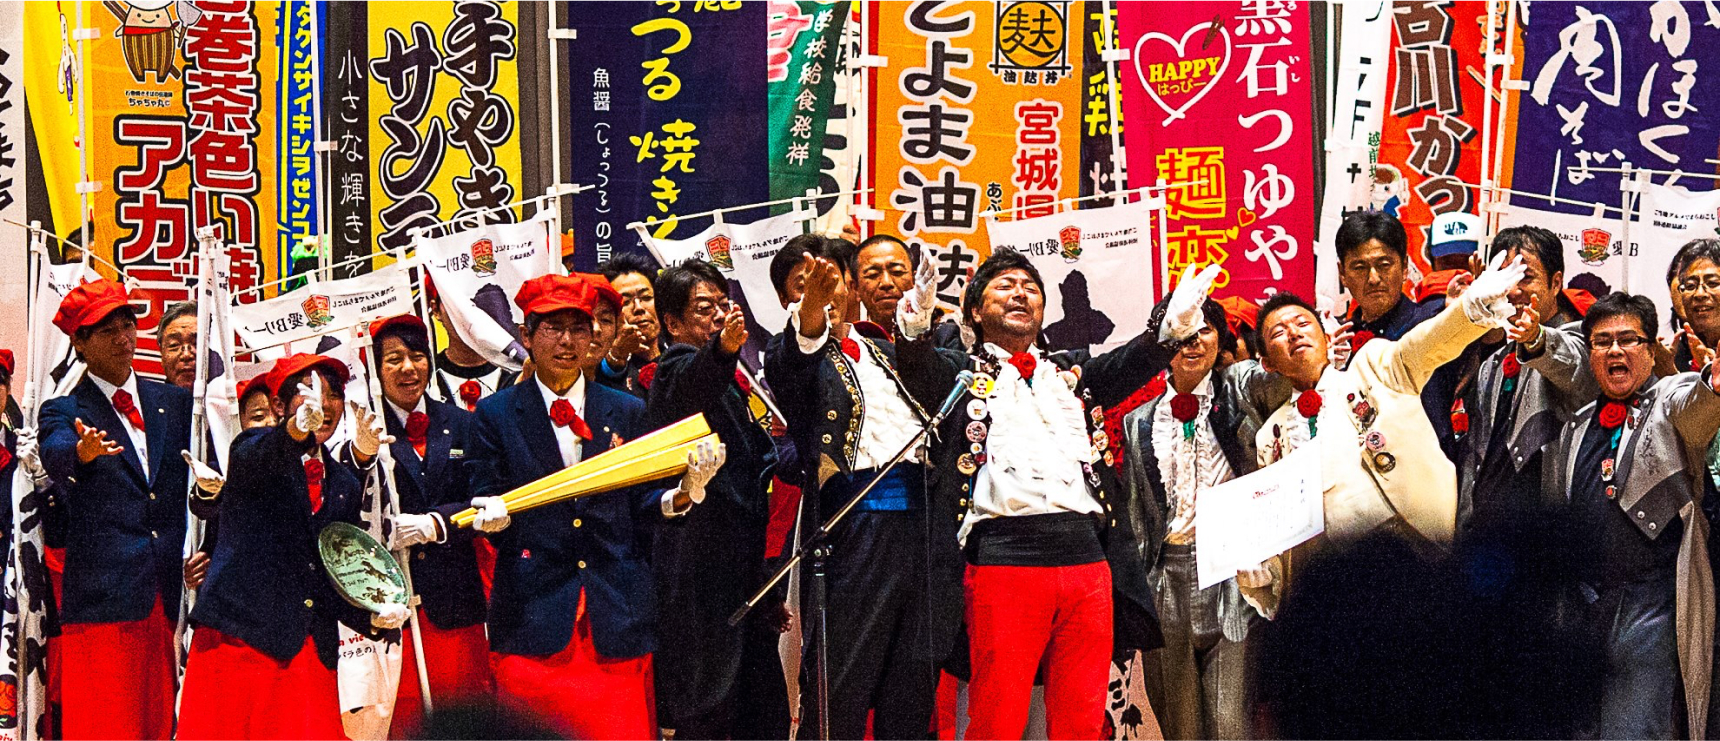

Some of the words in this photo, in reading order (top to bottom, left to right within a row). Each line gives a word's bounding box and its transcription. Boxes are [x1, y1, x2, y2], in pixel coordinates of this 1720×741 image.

[187, 0, 256, 308] 巻茶色い
[786, 9, 834, 167] 学校給食発祥
[1149, 56, 1221, 83] HAPPY
[1235, 0, 1299, 306] 黒石つゆや
